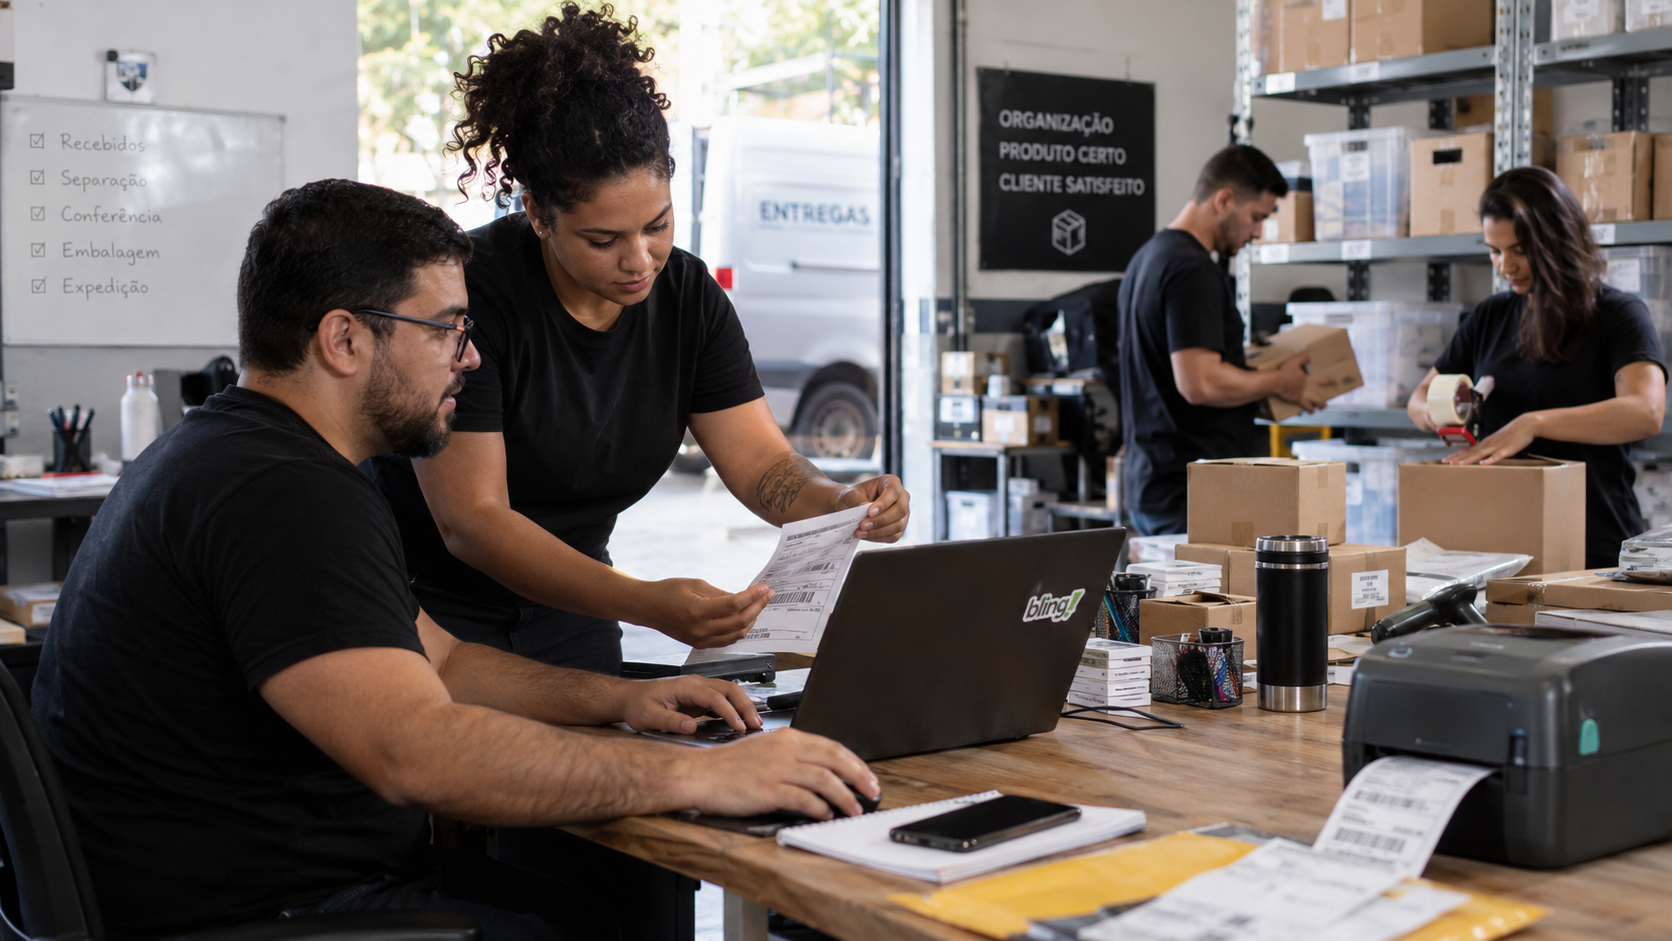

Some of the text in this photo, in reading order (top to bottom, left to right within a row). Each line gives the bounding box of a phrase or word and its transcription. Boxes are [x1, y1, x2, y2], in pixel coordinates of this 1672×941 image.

[999, 109, 1114, 137] ORGANIZAÇÃO
[61, 133, 145, 151] Recebidos
[999, 142, 1127, 165] PRODUTO CERTO
[61, 168, 148, 192] Separação
[999, 173, 1146, 196] CLIENTE SATISFEITO
[61, 205, 163, 225] Conferência
[760, 200, 871, 226] ENTREGAS
[62, 242, 160, 266] Embalagem
[62, 277, 150, 301] Expedição
[1025, 590, 1084, 620] bling!
